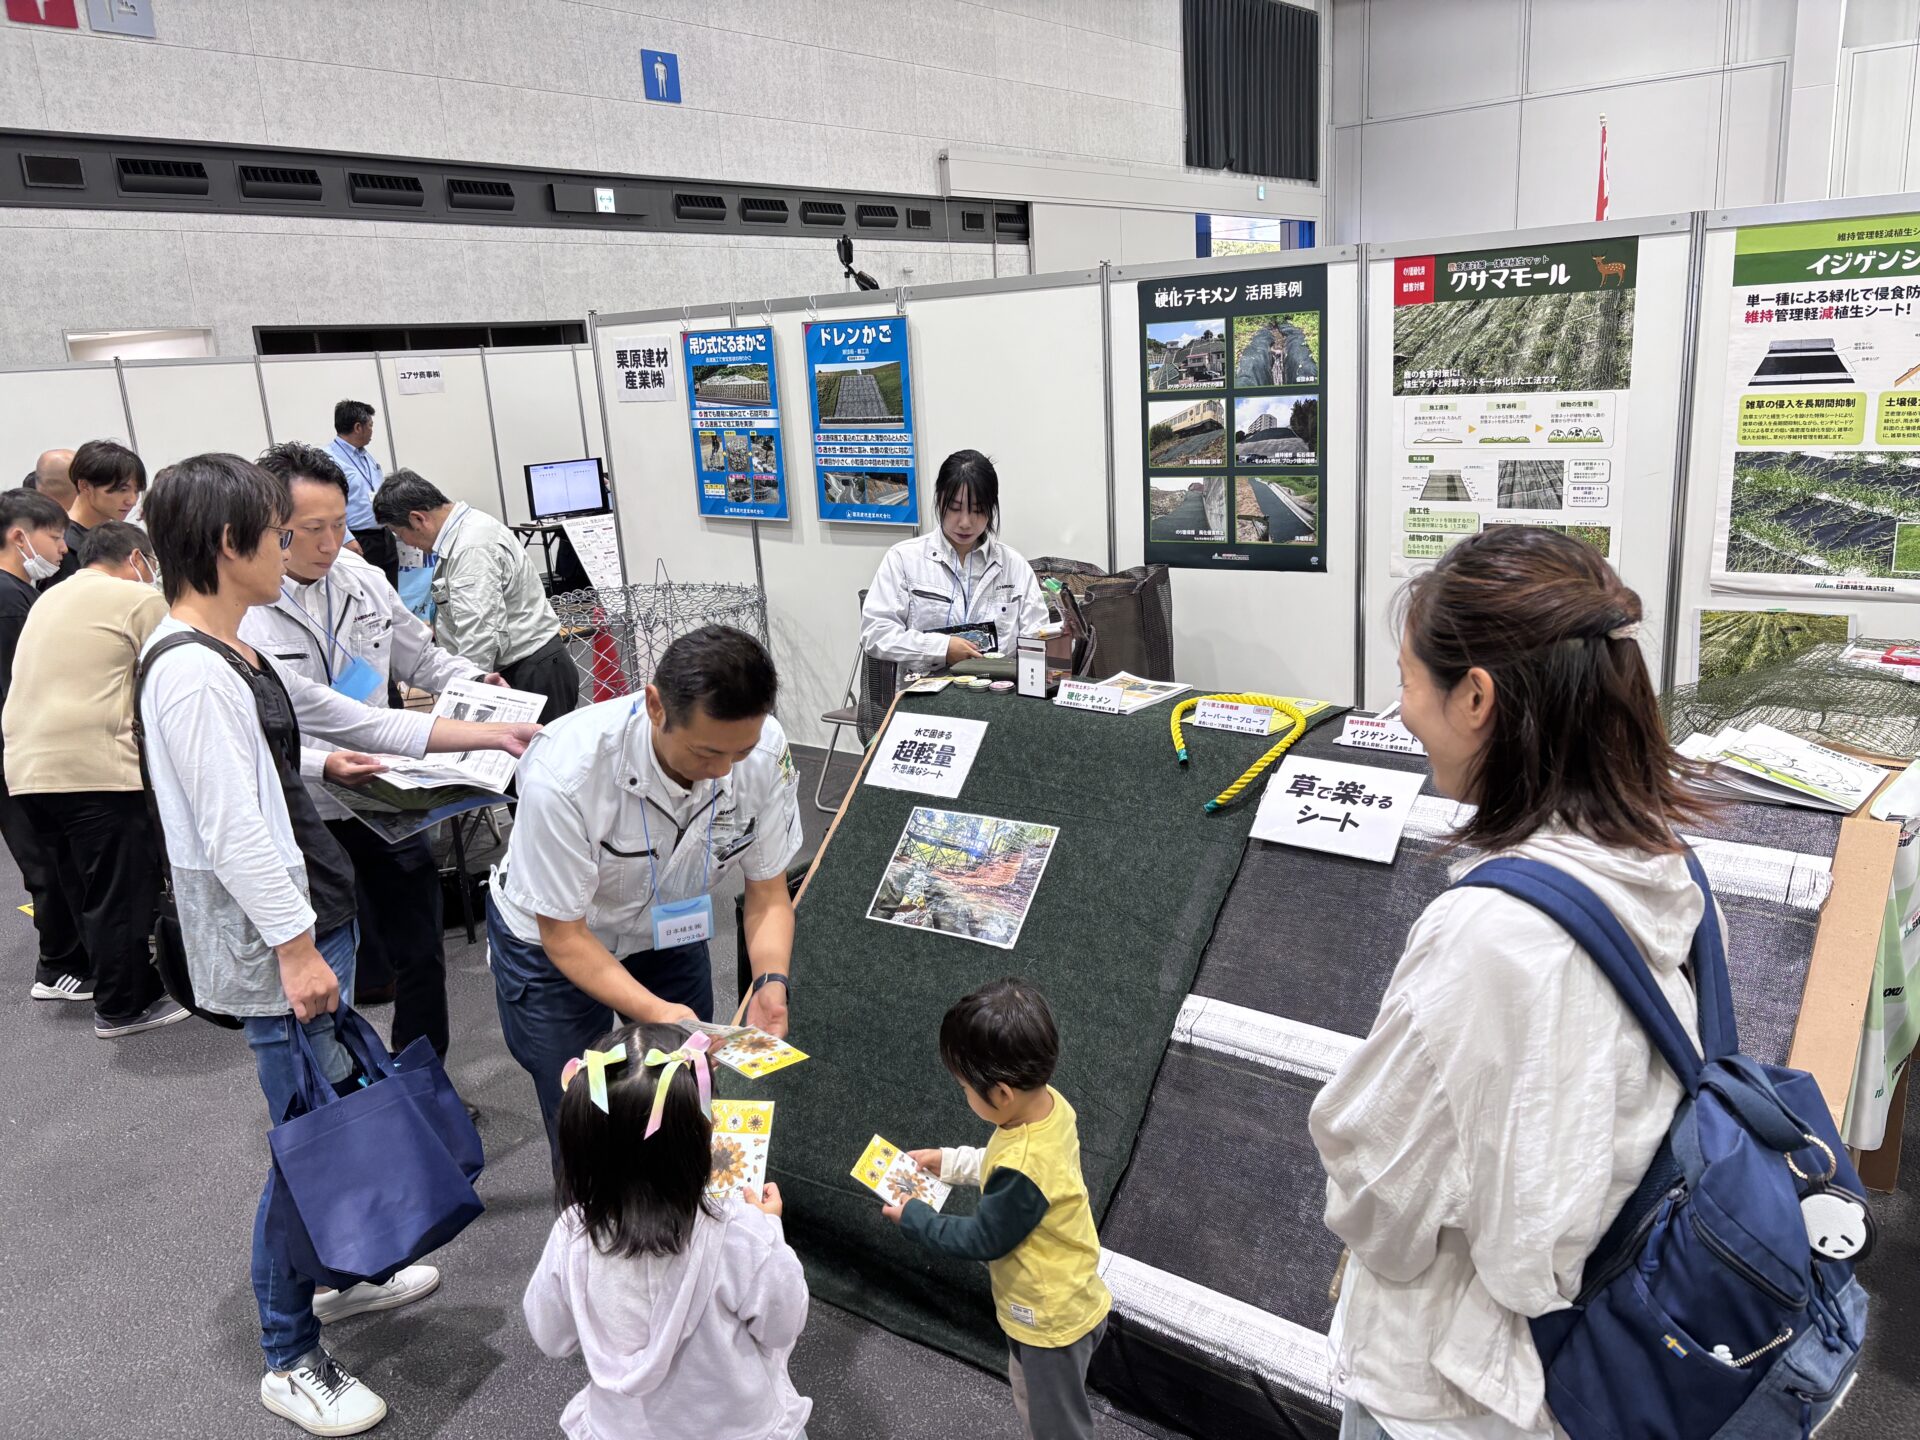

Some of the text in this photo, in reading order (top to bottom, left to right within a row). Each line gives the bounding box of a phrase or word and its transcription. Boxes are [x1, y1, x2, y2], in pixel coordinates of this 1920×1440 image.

[1806, 249, 1920, 275] イジゲンシ
[1451, 264, 1571, 292] クサマモール
[1155, 281, 1302, 308] 硬化テキメン 活用事例
[1746, 285, 1920, 307] 単一種による緑化で侵食防
[1744, 303, 1911, 324] 維持管理軽減植生シート!
[689, 334, 766, 355] 吊り式だるまかご
[820, 325, 892, 347] ドレンかご
[616, 347, 668, 369] 栗原建材
[1745, 398, 1856, 410] 雑草の侵入を長期間抑制
[1885, 397, 1920, 407] 土壌侵
[1067, 691, 1111, 704] 硬化テキメン
[914, 728, 952, 740] 水で固まる
[1350, 730, 1418, 744] イジゲンシート
[892, 739, 956, 768] 超軽量
[891, 763, 944, 778] 不思議なシート
[1286, 773, 1393, 810] 草で楽する
[1296, 804, 1360, 833] シート
